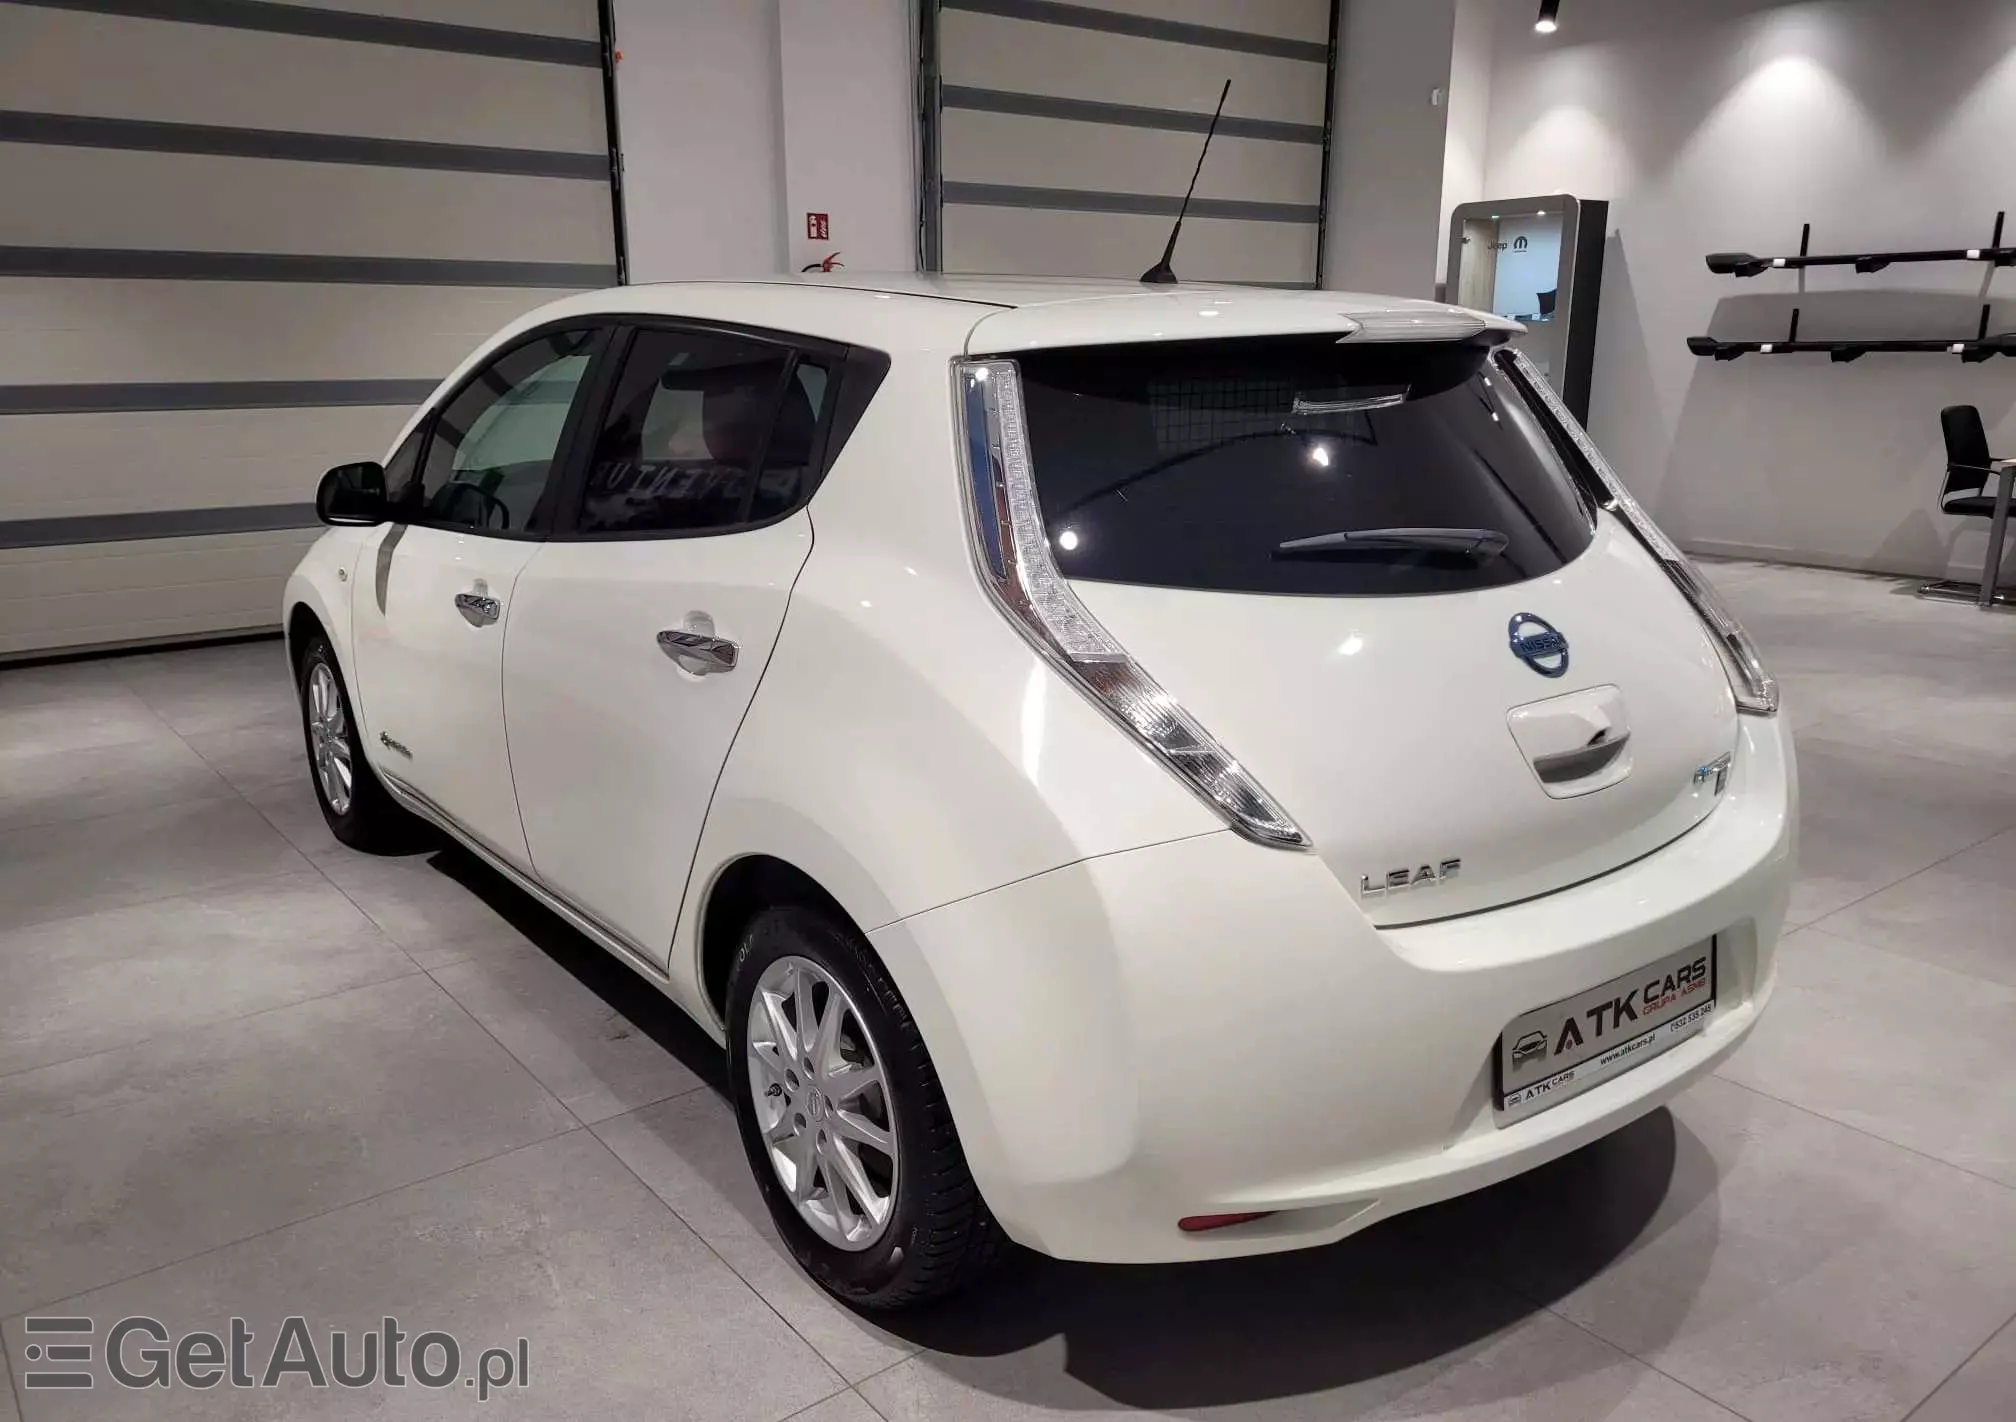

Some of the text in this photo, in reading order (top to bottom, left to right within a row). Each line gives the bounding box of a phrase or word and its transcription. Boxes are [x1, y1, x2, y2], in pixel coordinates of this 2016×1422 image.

[1361, 859, 1461, 895] LEAF
[1554, 956, 1706, 1056] ATK CARS
[1525, 1082, 1551, 1100] ATK
[1551, 1070, 1575, 1086] CARS
